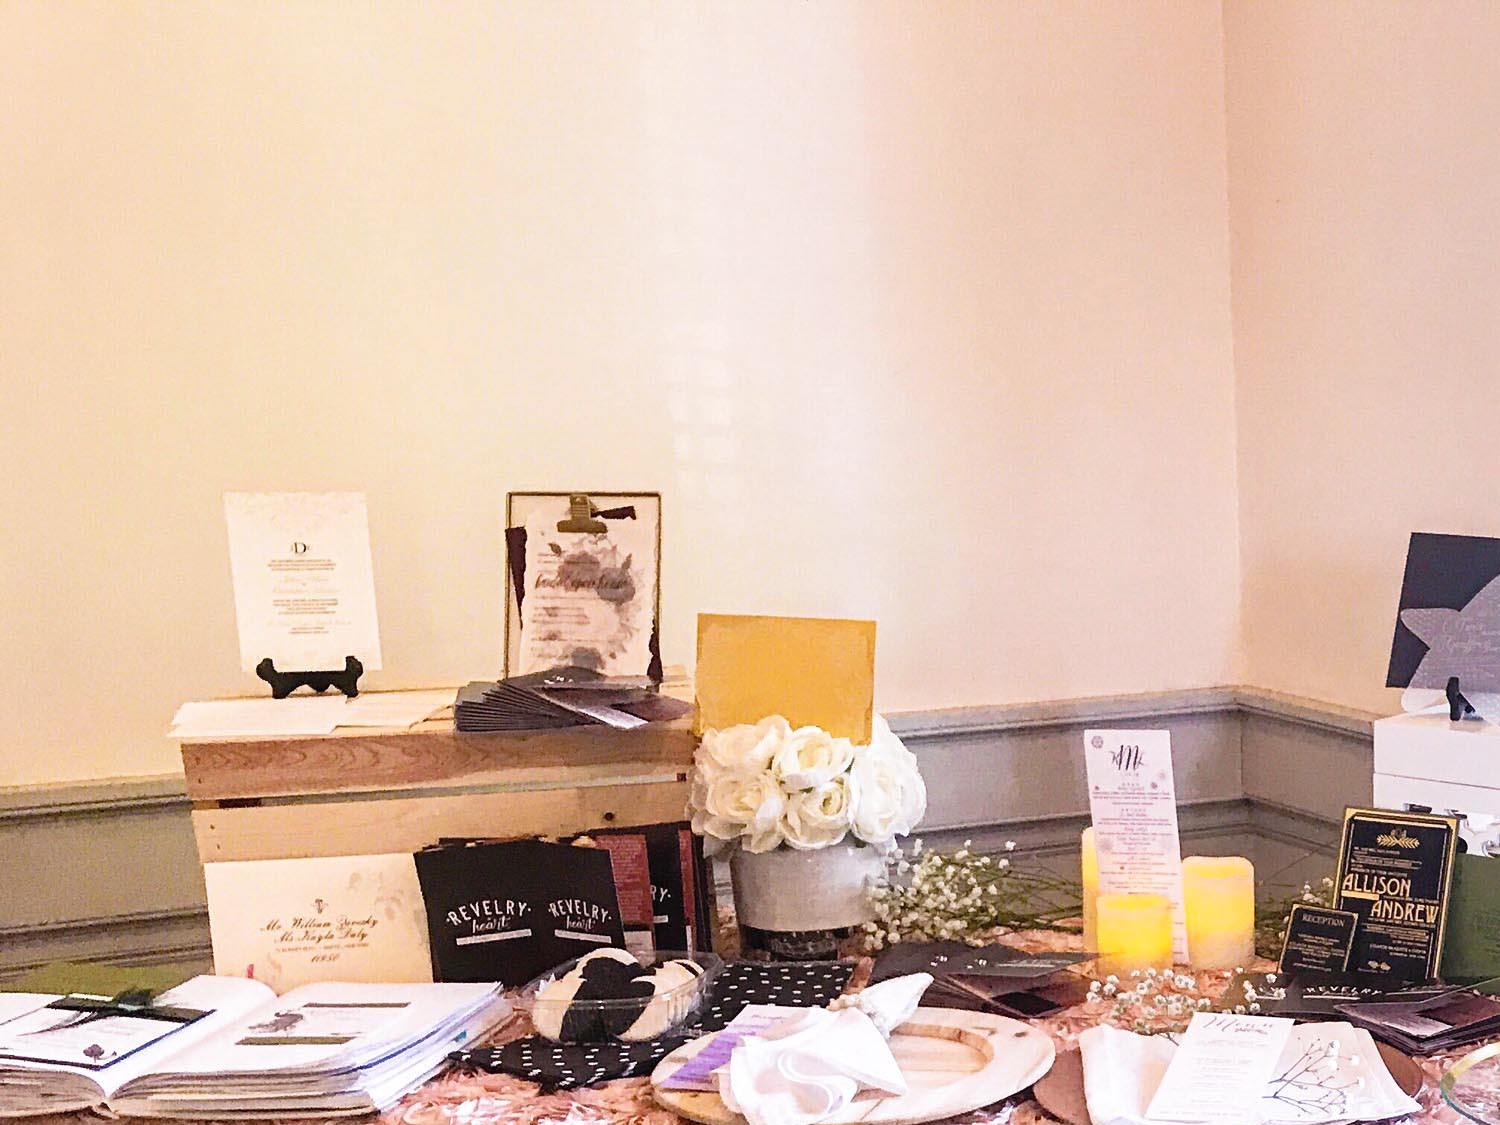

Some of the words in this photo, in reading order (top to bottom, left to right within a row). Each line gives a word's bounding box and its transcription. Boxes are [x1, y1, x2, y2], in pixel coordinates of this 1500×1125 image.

[1342, 873, 1412, 897] ALLISON
[448, 899, 528, 926] REVELRY
[549, 899, 609, 923] REVELRY
[1302, 913, 1344, 927] RECEPTION
[1370, 899, 1440, 924] ANDREW
[472, 915, 511, 933] heart
